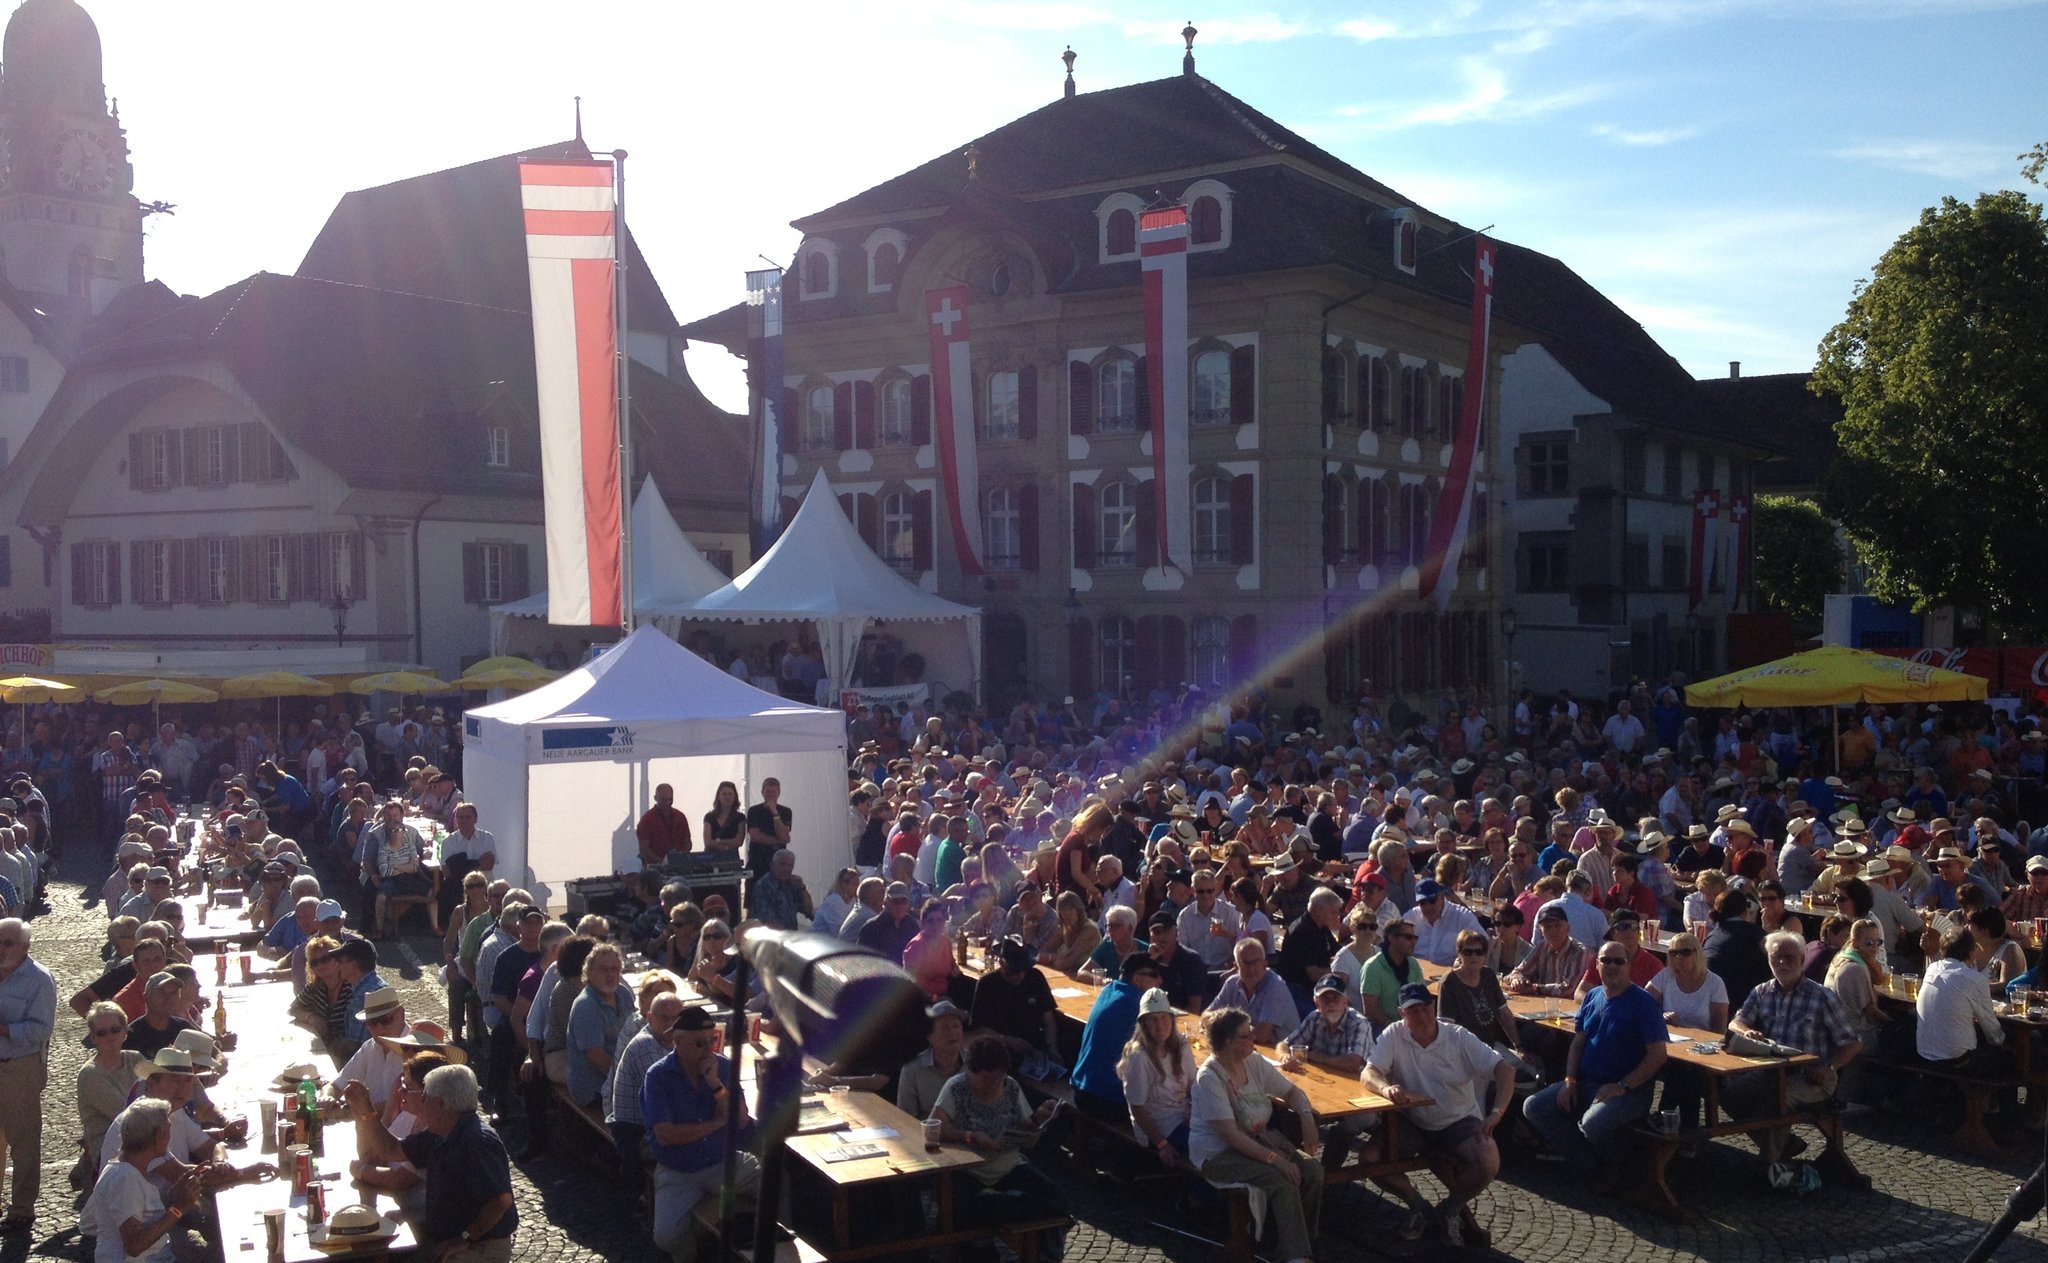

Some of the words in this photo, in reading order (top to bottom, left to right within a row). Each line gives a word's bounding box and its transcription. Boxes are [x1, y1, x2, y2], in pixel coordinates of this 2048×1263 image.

[543, 750, 565, 759] NEUE
[567, 747, 610, 758] AARGAUER
[612, 746, 634, 755] BANK
